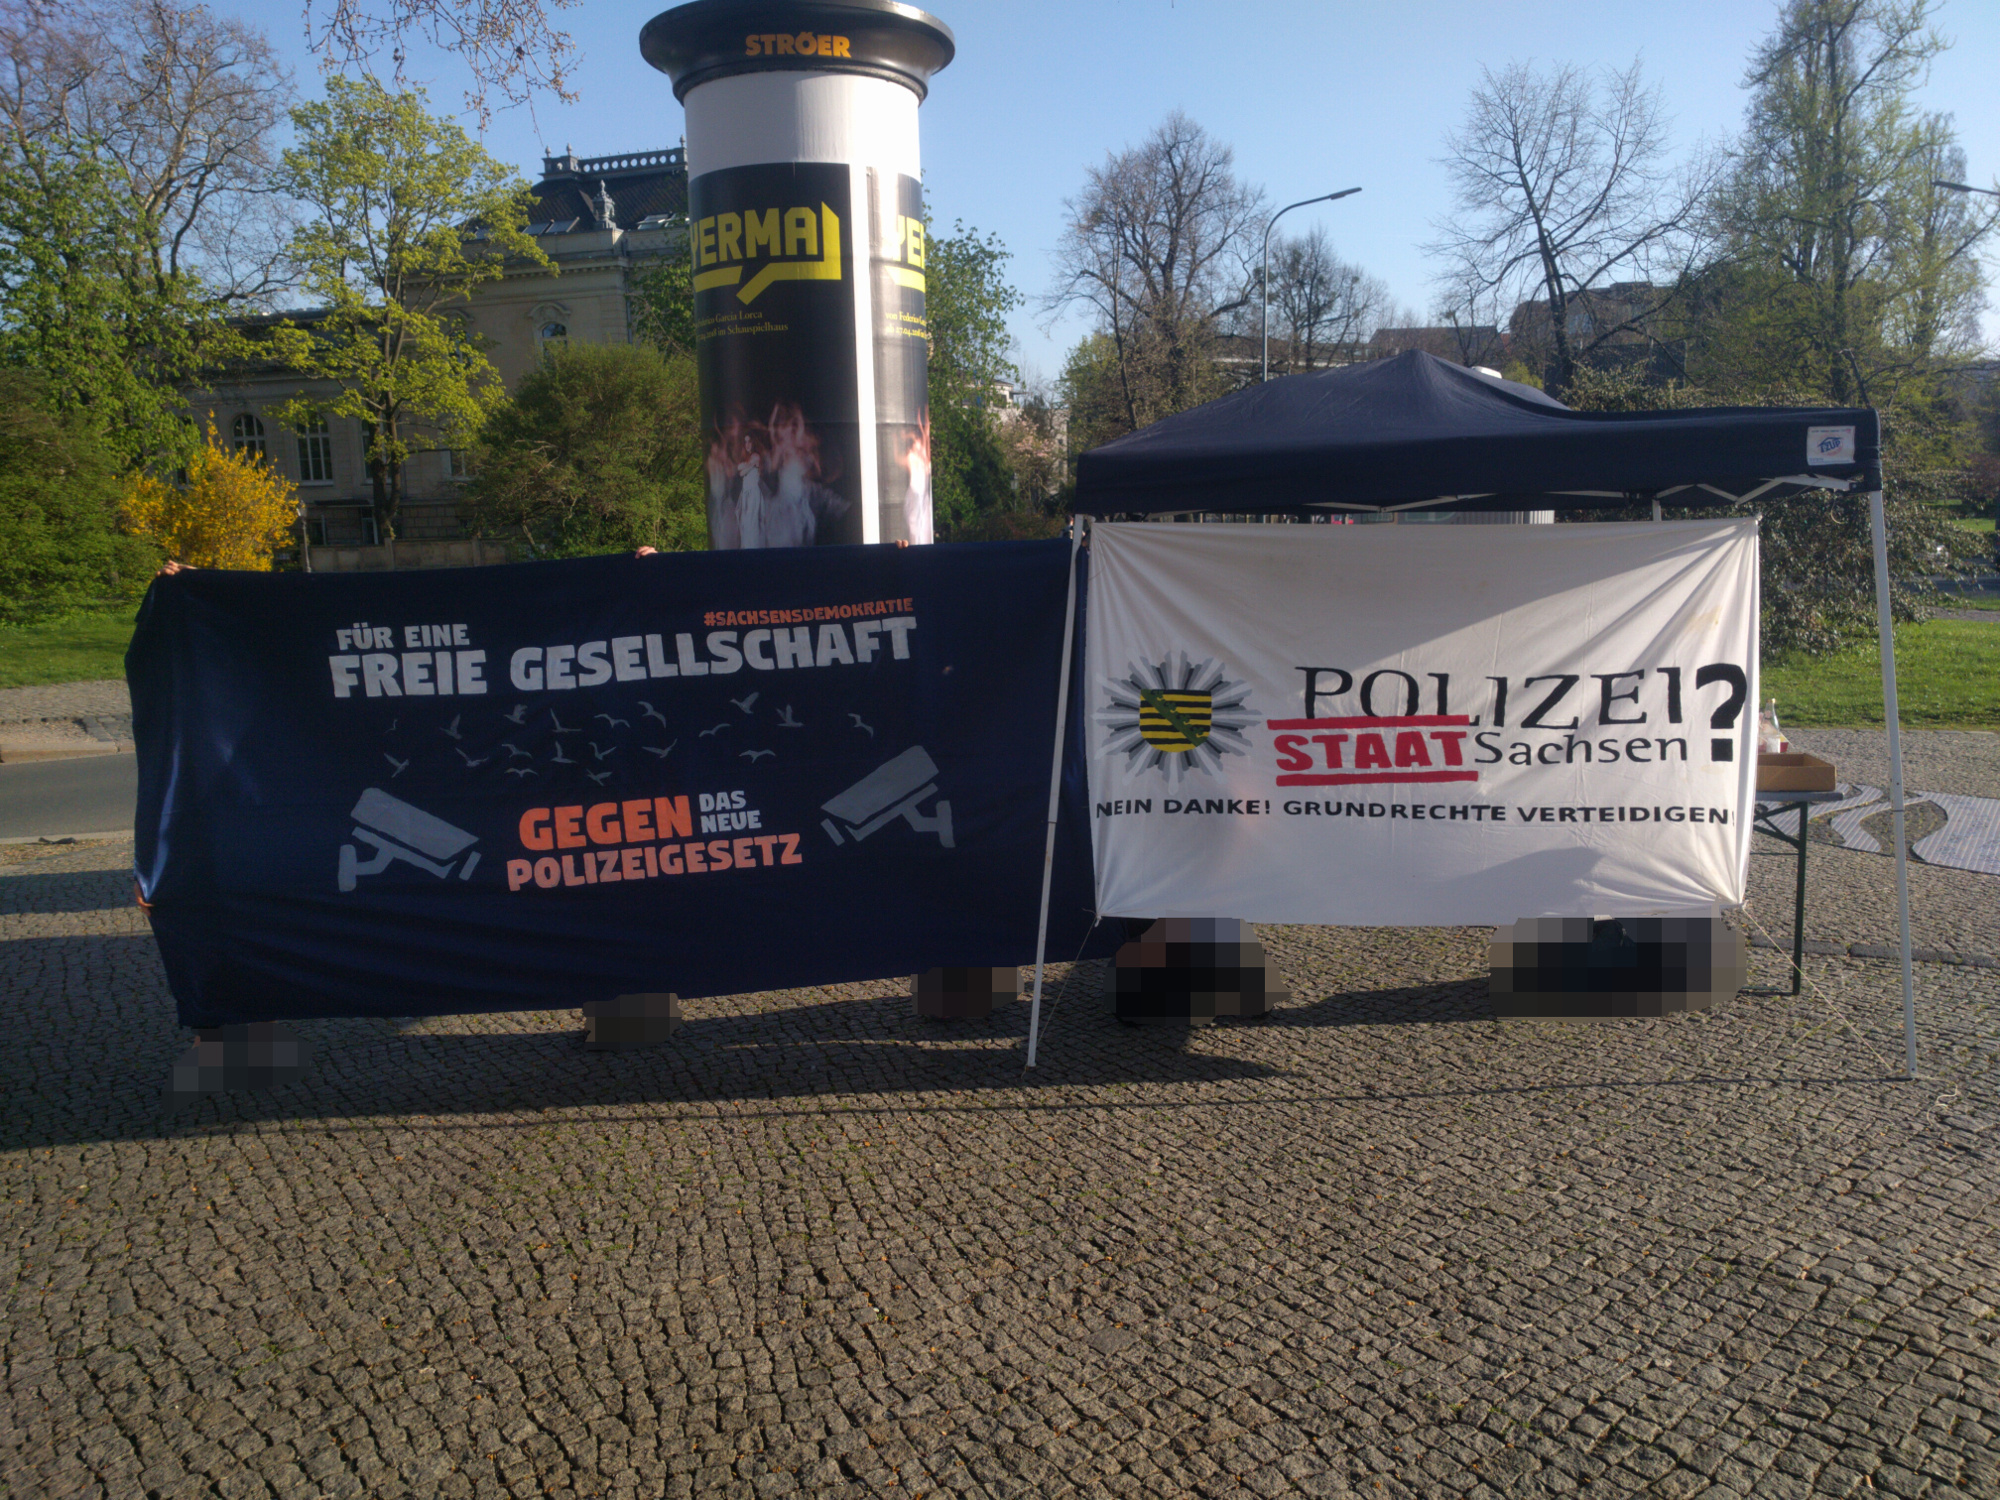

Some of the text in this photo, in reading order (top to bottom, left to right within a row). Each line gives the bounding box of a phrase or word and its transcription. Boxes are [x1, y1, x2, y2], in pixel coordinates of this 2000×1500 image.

[745, 32, 852, 58] STRÖER
[690, 206, 818, 270] YERMA
[718, 327, 726, 336] im
[727, 321, 789, 336] Schauspielhaus
[739, 310, 763, 321] Lorca
[704, 598, 913, 627] #SACHSENSDEMOKRATIE
[336, 622, 470, 650] FÜR EINE
[329, 616, 917, 698] FREIE GESELLSCHAFT
[1274, 731, 1688, 771] STAAT Sachsen
[699, 790, 747, 813] DAS
[1097, 799, 1152, 818] NEIN
[1164, 799, 1270, 815] DANKE!
[1283, 800, 1506, 822] GRUNDRECHTE
[519, 795, 693, 851] GEGEN
[701, 810, 762, 834] NEUE
[507, 833, 802, 892] POLIZEIGESETZ
